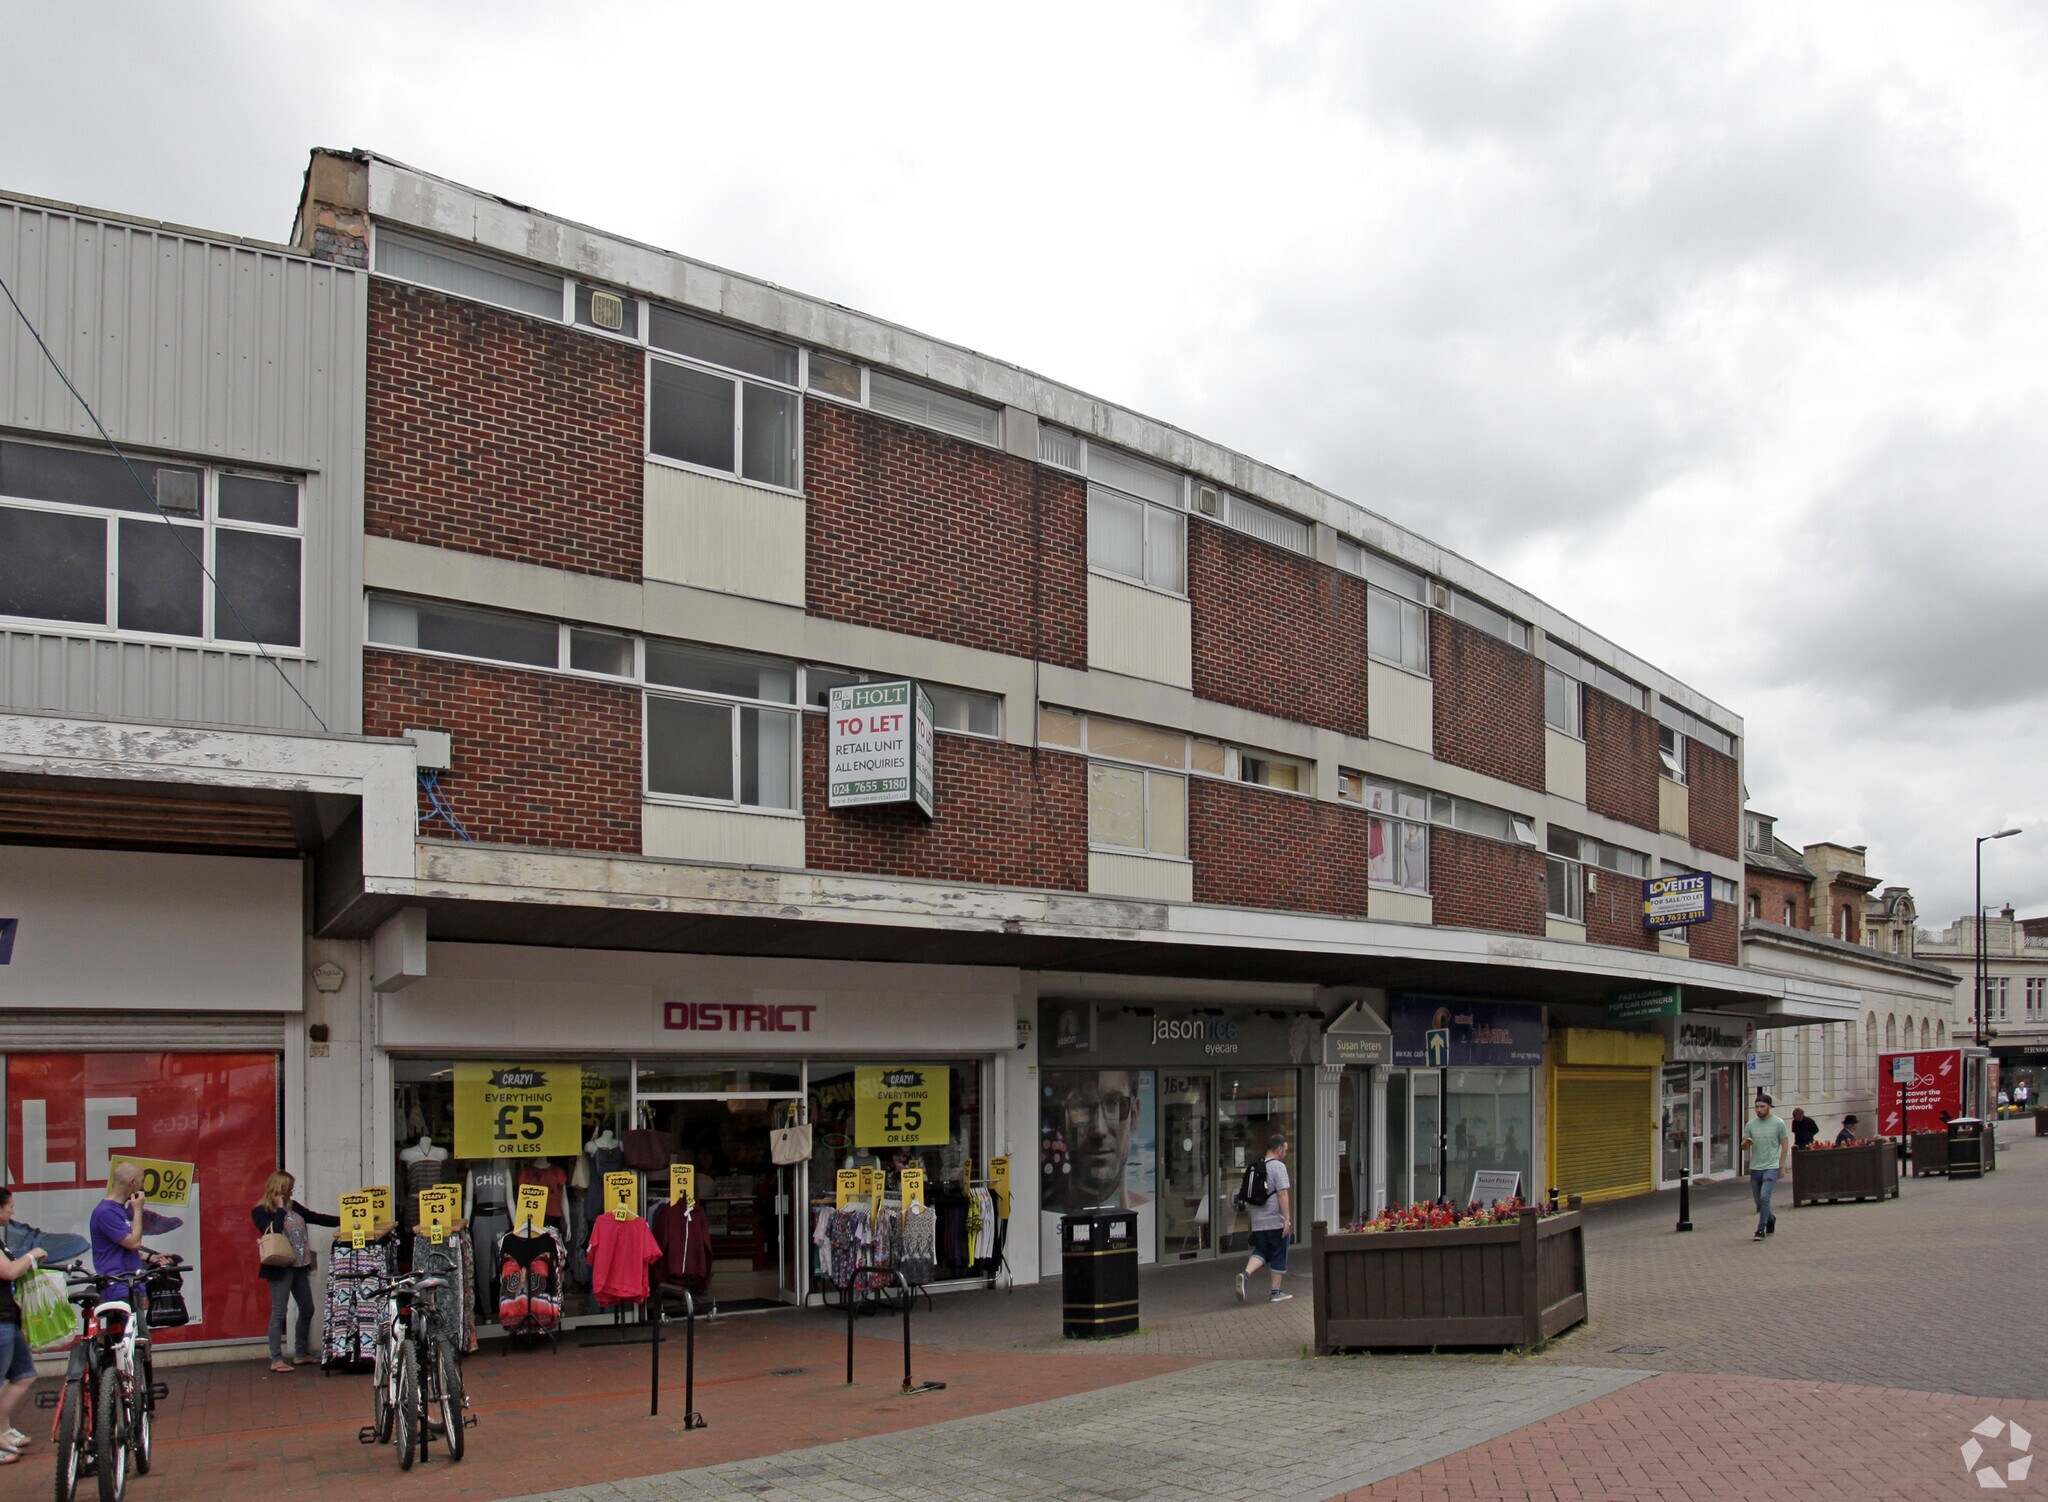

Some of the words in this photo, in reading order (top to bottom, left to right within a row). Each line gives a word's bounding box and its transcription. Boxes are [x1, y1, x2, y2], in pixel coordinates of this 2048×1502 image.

[855, 687, 905, 706] HOLT
[836, 718, 863, 736] TO
[870, 715, 904, 733] LET
[836, 742, 872, 756] RETAIL
[874, 740, 903, 752] UNIT
[835, 762, 852, 773] ALL
[853, 757, 905, 771] ENQUIRIES
[833, 784, 850, 795] 024
[855, 781, 878, 792] 7655
[882, 779, 905, 790] 5180
[1650, 877, 1704, 894] LOVEITTS
[1665, 895, 1691, 904] SALE/TO
[1693, 893, 1703, 901] LET
[1650, 916, 1665, 924] 024
[1667, 913, 1687, 922] 7622
[1689, 910, 1705, 919] 8111
[1638, 989, 1662, 999] LOANS
[1609, 1002, 1624, 1011] FOR
[1625, 1000, 1640, 1009] CAR
[1641, 996, 1673, 1006] OWNERS
[664, 1002, 817, 1032] DISTRICT
[1204, 1042, 1239, 1055] eyecare
[1336, 1039, 1358, 1051] Susan
[1360, 1039, 1382, 1051] Peters
[502, 1074, 533, 1085] CRAZY!
[890, 1075, 914, 1084] CRAZY!
[485, 1093, 552, 1102] EVERYTHING
[878, 1091, 928, 1099] EVERYTHING
[1896, 1098, 1919, 1106] pwer
[884, 1101, 922, 1131] £5
[494, 1105, 544, 1140] £5
[887, 1134, 901, 1143] OR
[902, 1134, 919, 1142] LESS
[498, 1144, 514, 1153] OR
[517, 1143, 541, 1152] LESS
[475, 1174, 505, 1186] CHIC
[845, 1181, 855, 1189] £3
[909, 1181, 920, 1189] £3
[160, 1190, 185, 1200] OFF!
[373, 1200, 385, 1208] £3
[430, 1204, 445, 1213] £3
[525, 1200, 539, 1209] £5
[352, 1208, 367, 1217] £3
[353, 1238, 364, 1246] £3
[432, 1233, 442, 1241] £3
